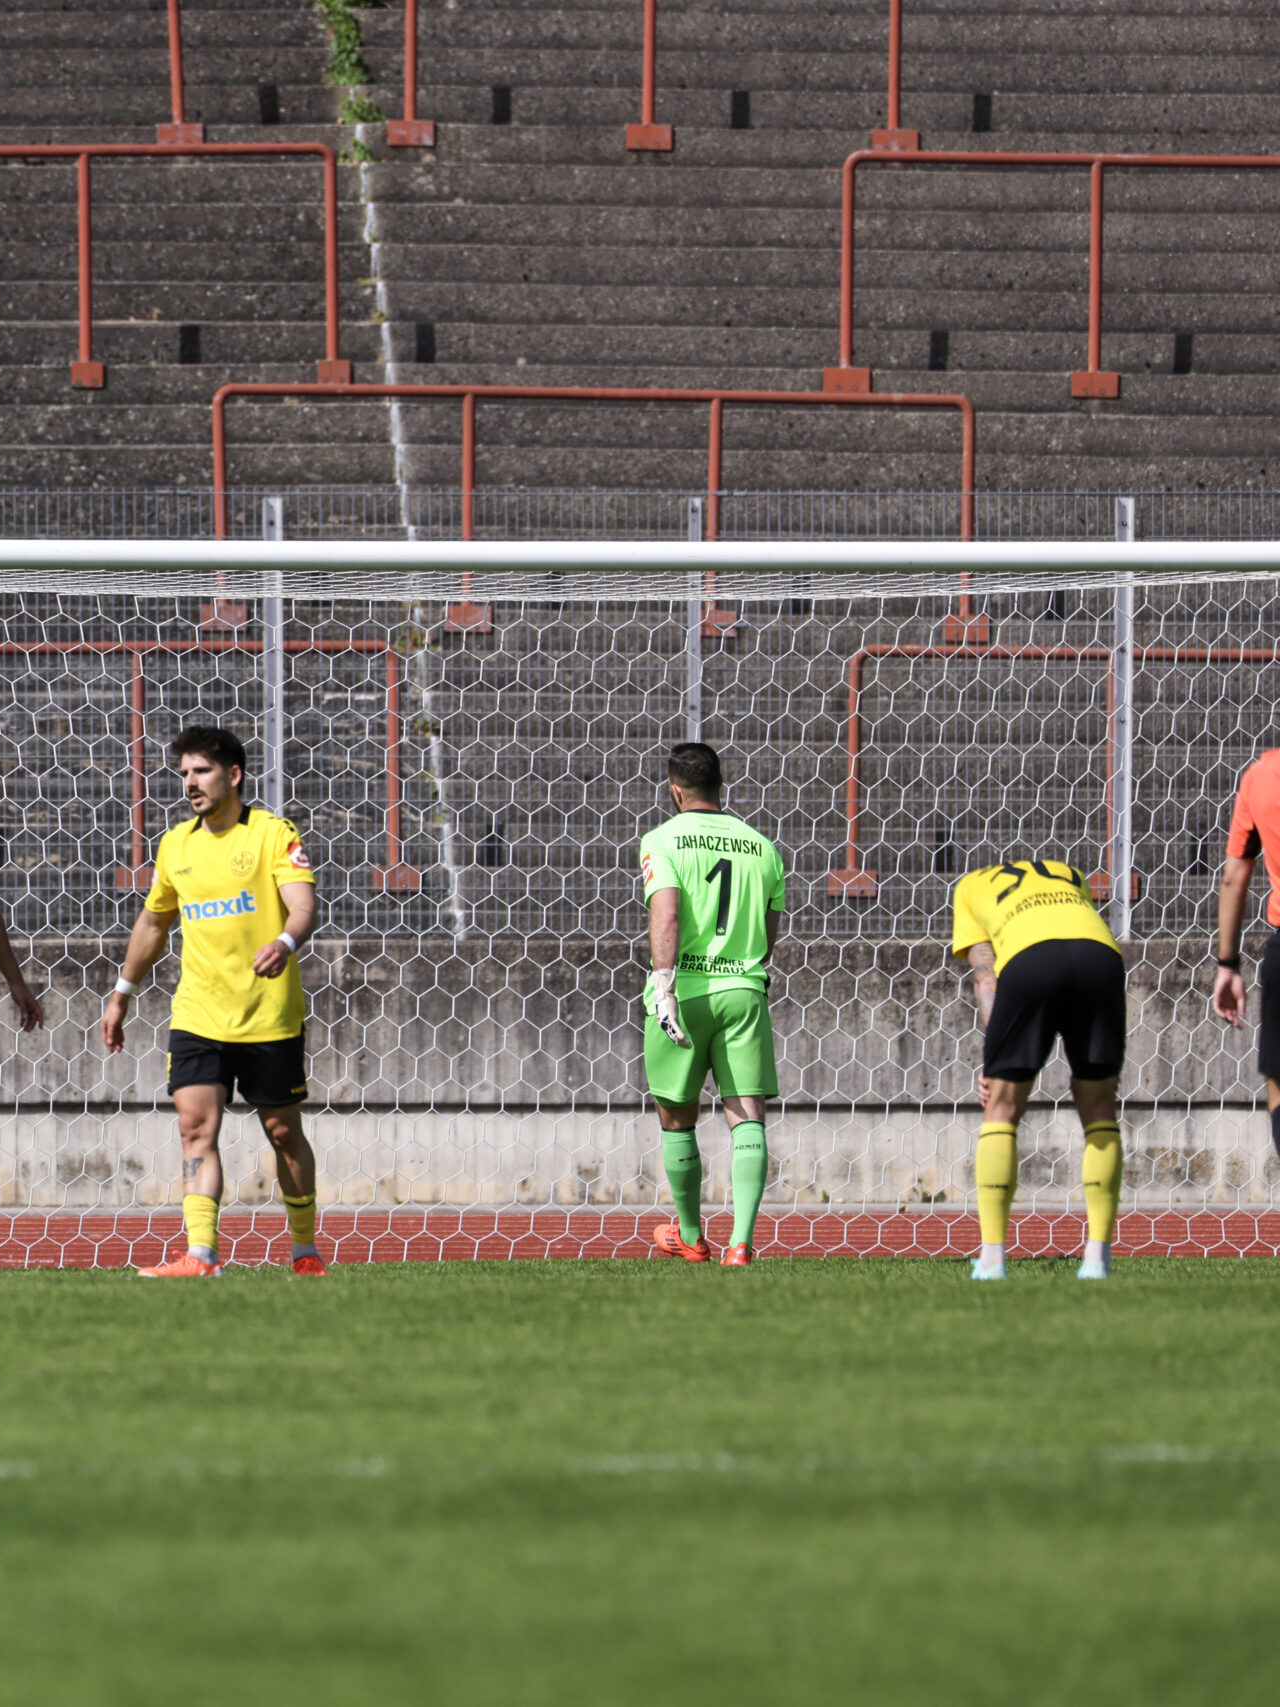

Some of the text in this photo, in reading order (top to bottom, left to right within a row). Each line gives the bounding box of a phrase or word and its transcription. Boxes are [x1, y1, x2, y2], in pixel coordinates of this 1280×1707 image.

[674, 835, 762, 857] ZAHACZEWSKI
[182, 890, 256, 920] maxit
[705, 858, 732, 936] 1
[680, 962, 746, 975] BRAUHAUS
[682, 953, 744, 967] BAYREUTHER
